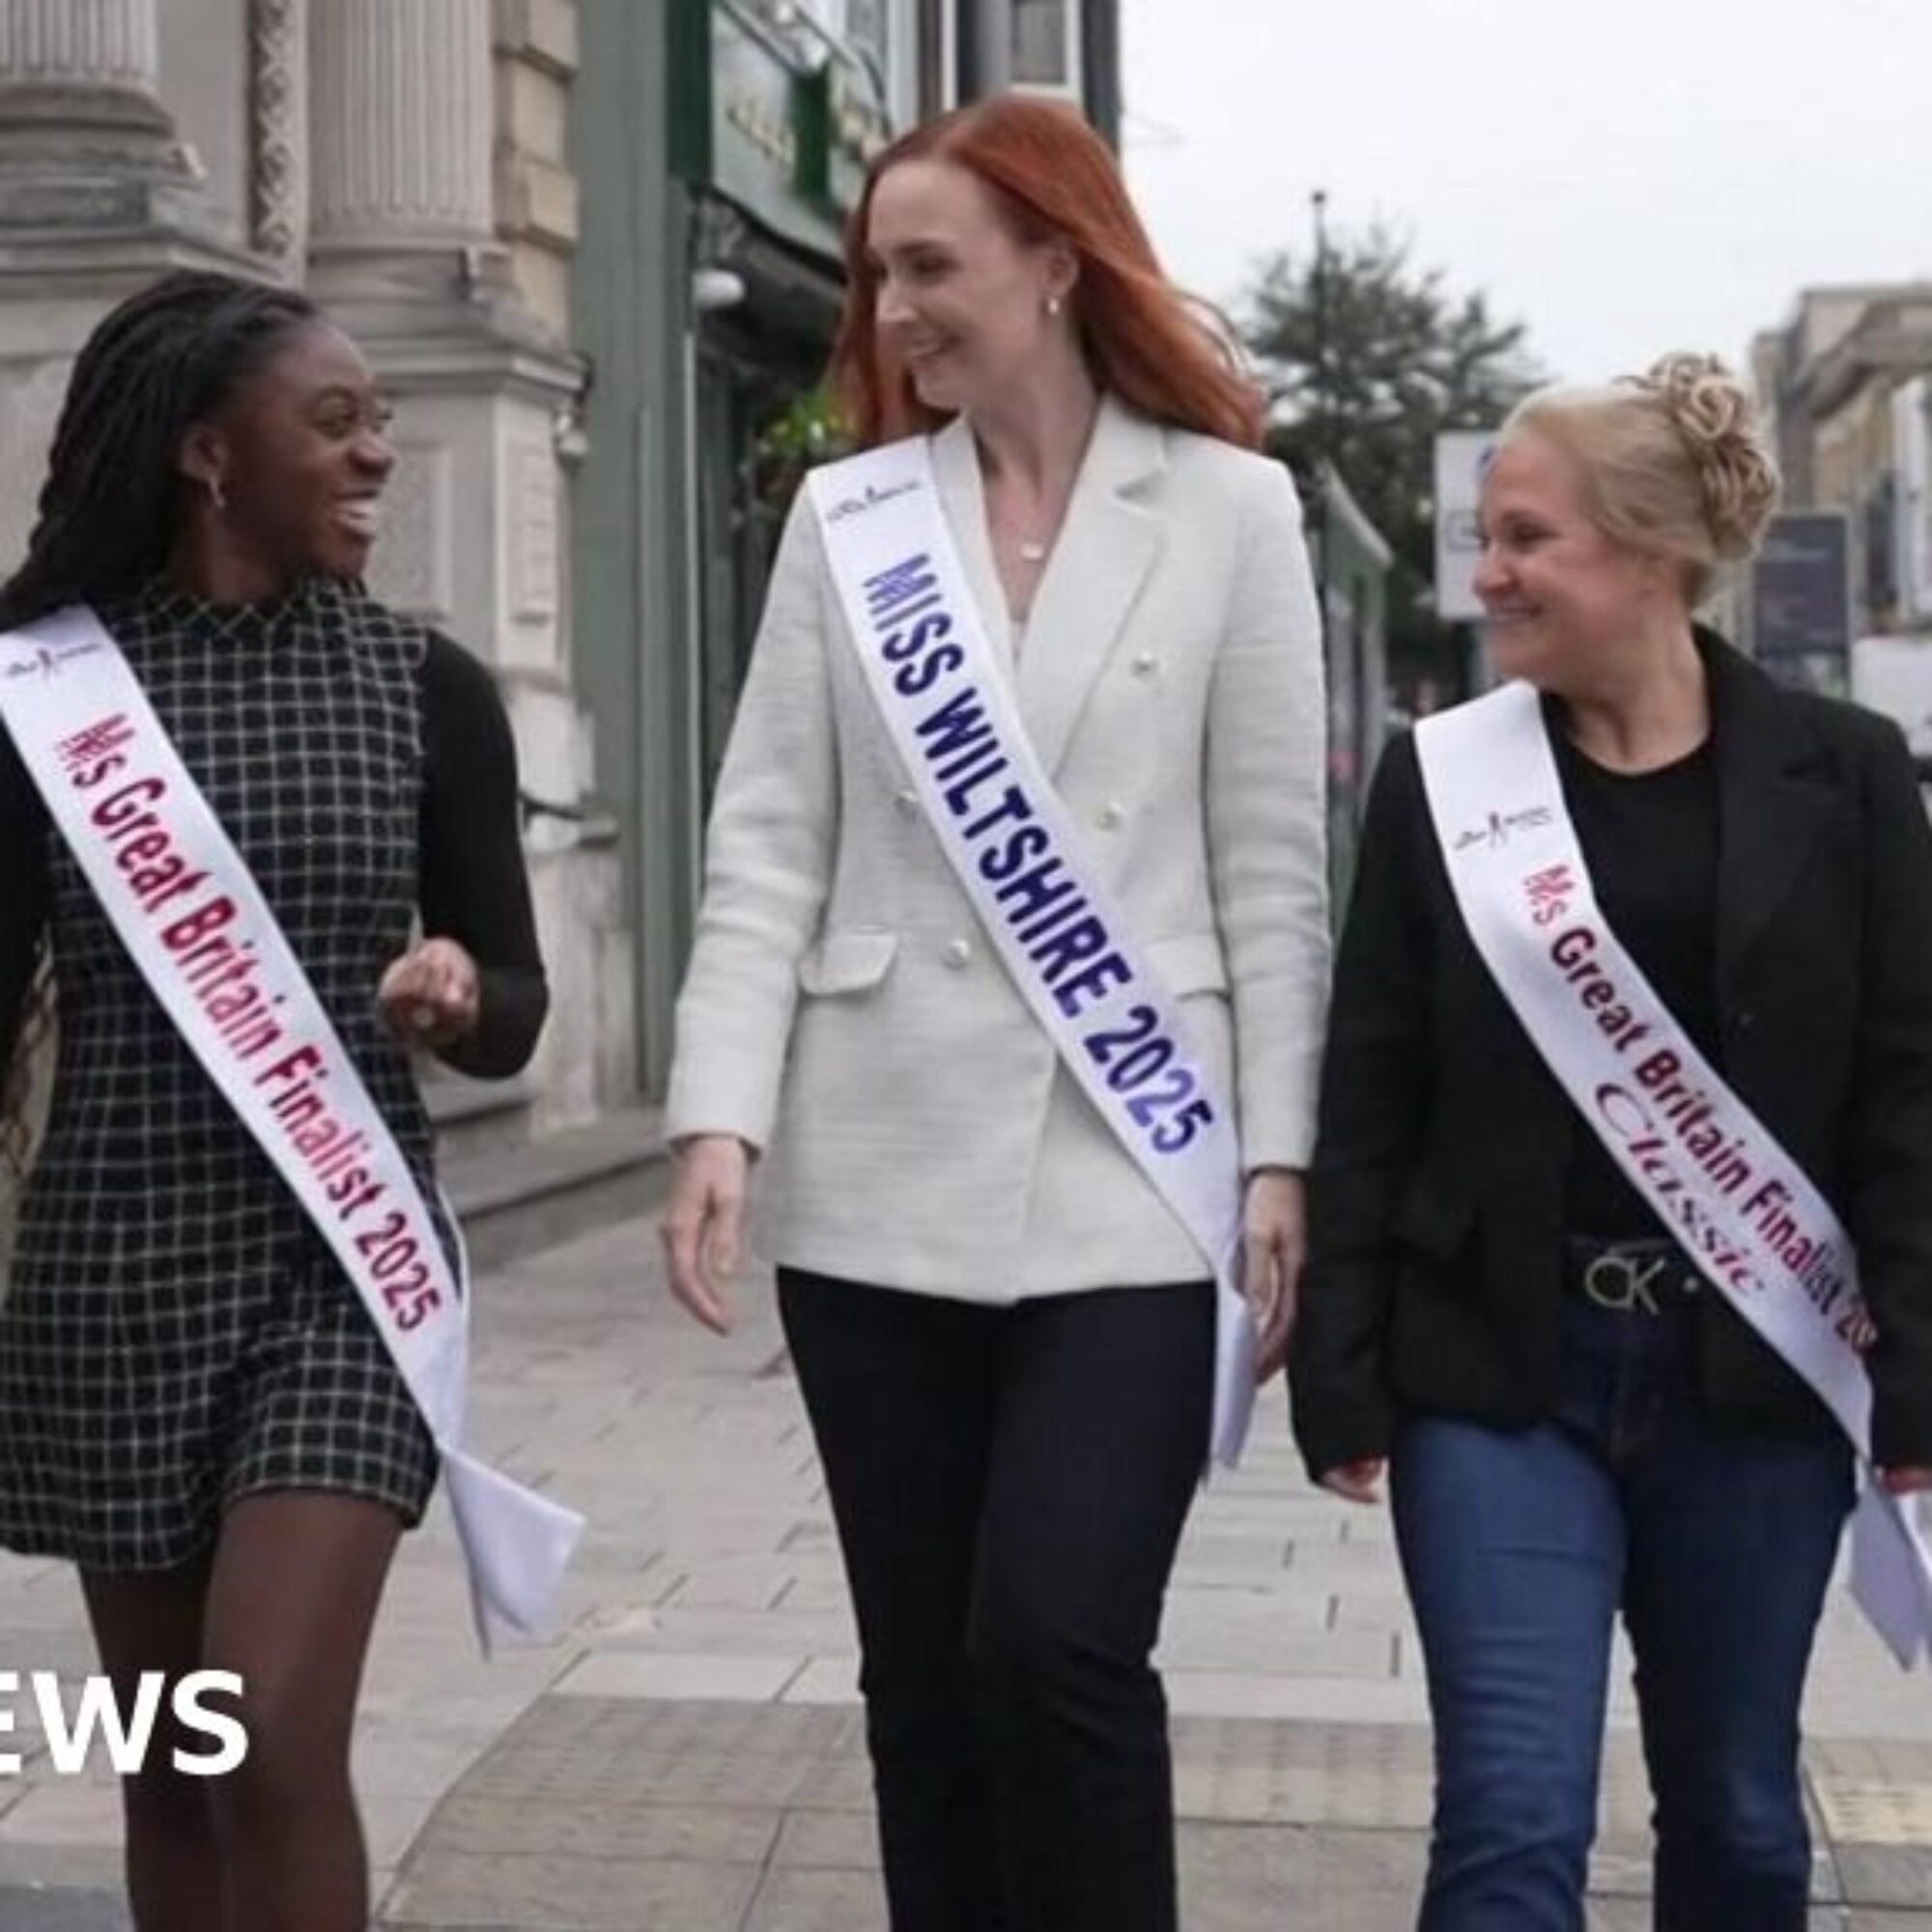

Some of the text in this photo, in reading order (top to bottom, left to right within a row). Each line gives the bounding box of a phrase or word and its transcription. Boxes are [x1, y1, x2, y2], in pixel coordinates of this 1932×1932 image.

[56, 712, 443, 1333] Ms Great Britain Finalist 2025
[862, 554, 964, 696] MISS
[914, 687, 1133, 1019] WILTSHIRE
[1083, 1004, 1215, 1153] 2025
[1522, 864, 1576, 925] Ms
[1549, 927, 1652, 1055] Great
[1633, 1047, 1752, 1196] Britain
[1739, 1178, 1846, 1316] Finalist
[1584, 1254, 1668, 1316] CK
[1595, 1082, 1765, 1297] Classic
